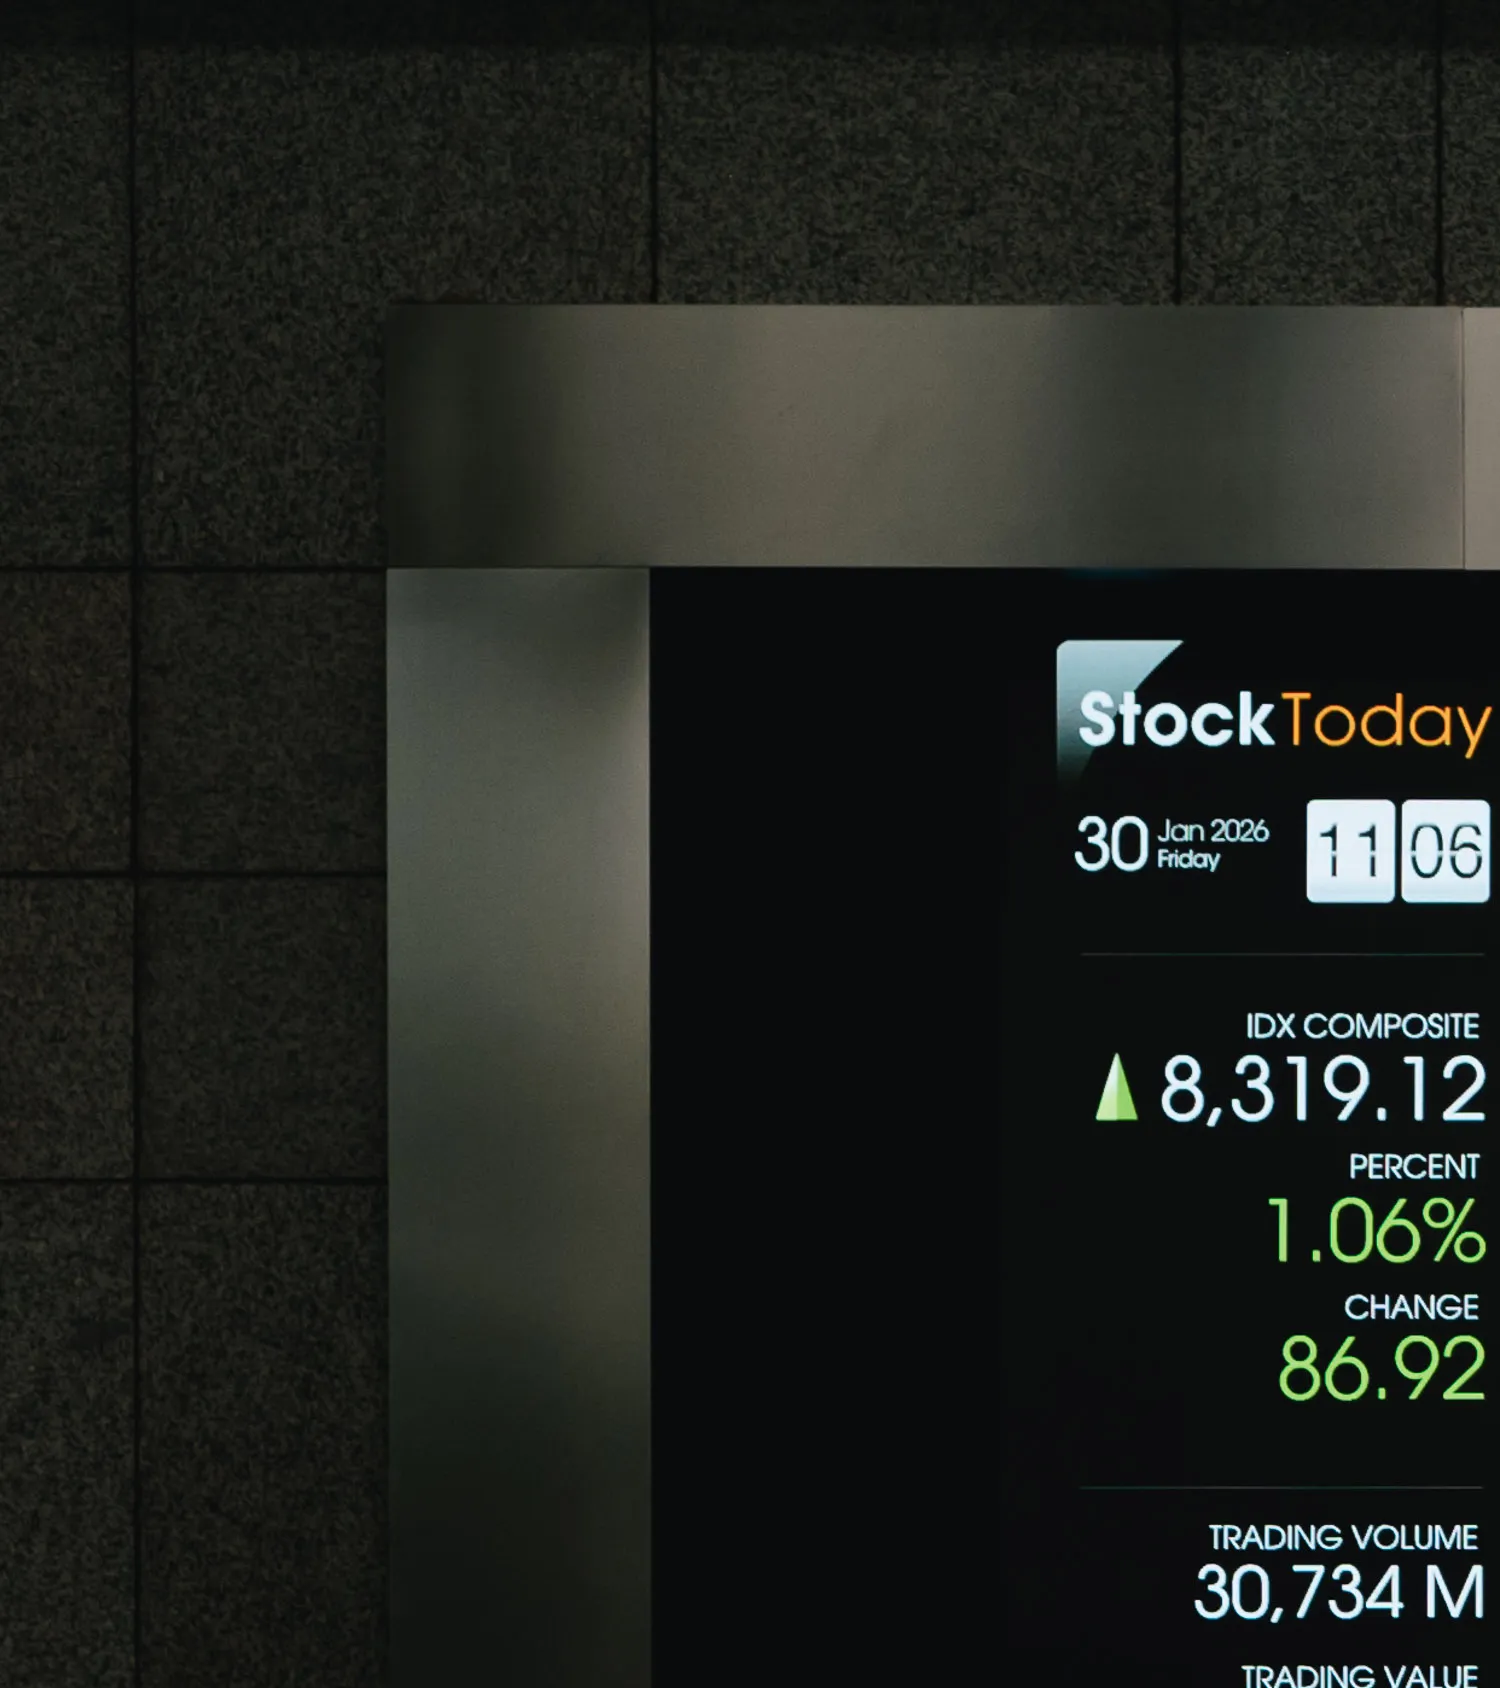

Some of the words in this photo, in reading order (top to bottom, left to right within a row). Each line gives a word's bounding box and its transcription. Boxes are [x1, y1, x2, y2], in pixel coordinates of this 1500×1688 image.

[1075, 816, 1148, 871] 30
[1158, 819, 1204, 842] Jan
[1211, 819, 1269, 842] 2026
[1158, 849, 1220, 872] Friday
[1319, 823, 1377, 877] 11
[1410, 823, 1483, 879] 06
[1248, 1013, 1296, 1038] IDX
[1304, 1013, 1479, 1039] COMPOSITE
[1162, 1055, 1486, 1127] 8,319.12
[1351, 1153, 1480, 1179] PERCENT
[1269, 1197, 1486, 1263] 1.06%
[1345, 1294, 1478, 1320] CHANGE
[1279, 1335, 1485, 1401] 86.92
[1209, 1525, 1343, 1550] TRADING
[1351, 1524, 1478, 1550] VOLUME
[1195, 1564, 1404, 1623] 30,734
[1427, 1565, 1483, 1618] M
